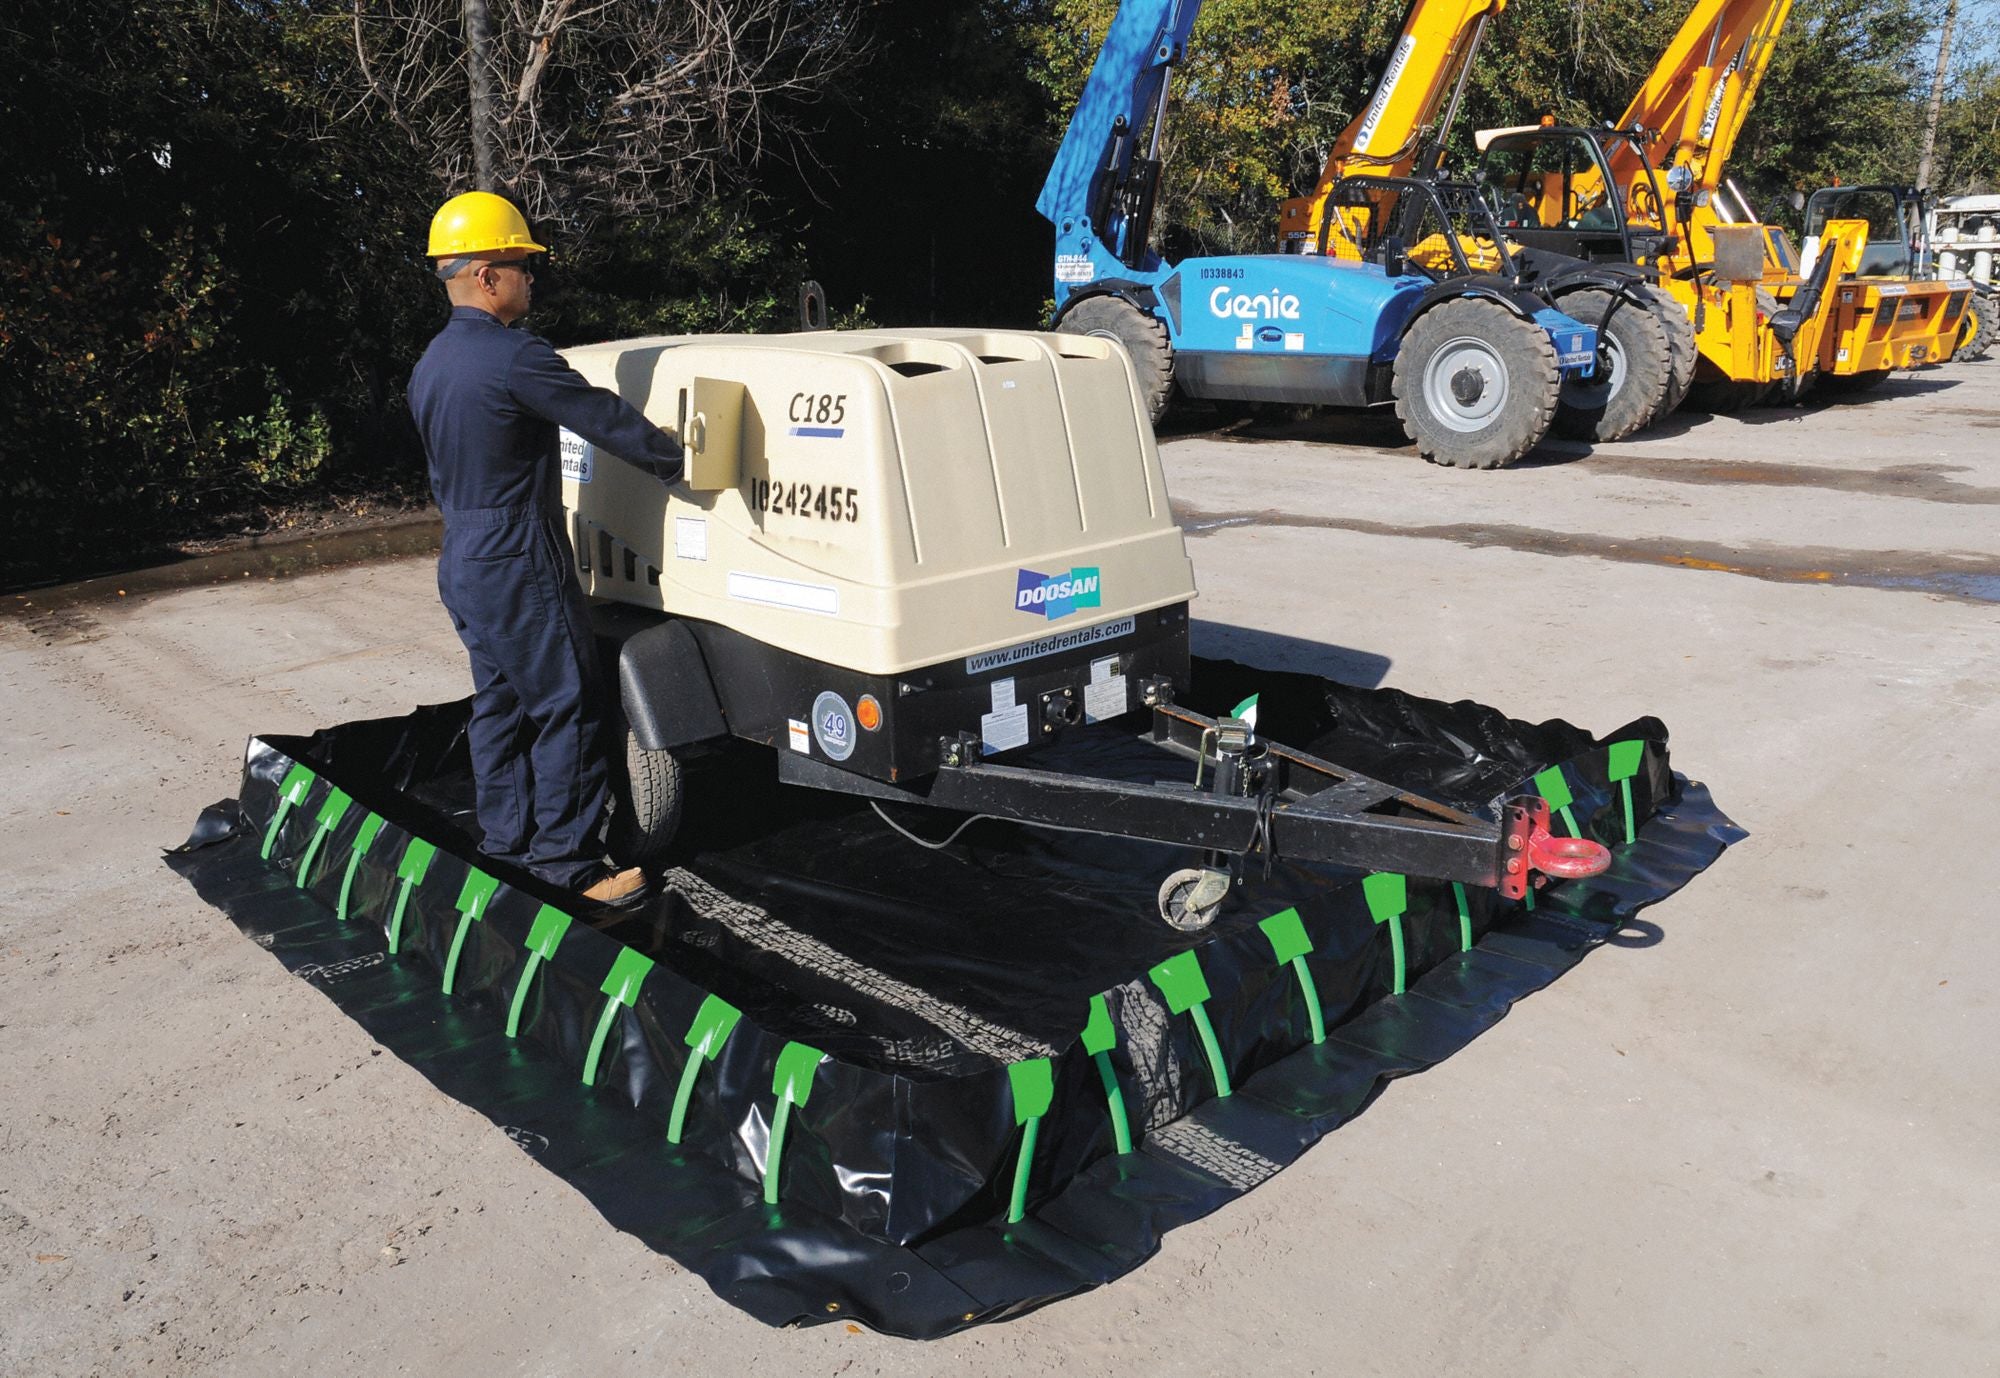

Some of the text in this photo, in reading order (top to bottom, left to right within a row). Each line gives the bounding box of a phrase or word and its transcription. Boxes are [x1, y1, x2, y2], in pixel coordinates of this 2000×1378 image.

[1364, 42, 1411, 130] United Rentals
[1200, 268, 1245, 280] 10338843
[1210, 285, 1300, 319] Genie
[789, 392, 847, 425] C185
[560, 438, 585, 455] nited
[562, 457, 588, 474] ntals
[751, 477, 858, 523] 10242455
[1018, 576, 1098, 607] DOOSAN
[971, 619, 1132, 671] www.unitedrentals.com
[824, 712, 846, 738] 49
